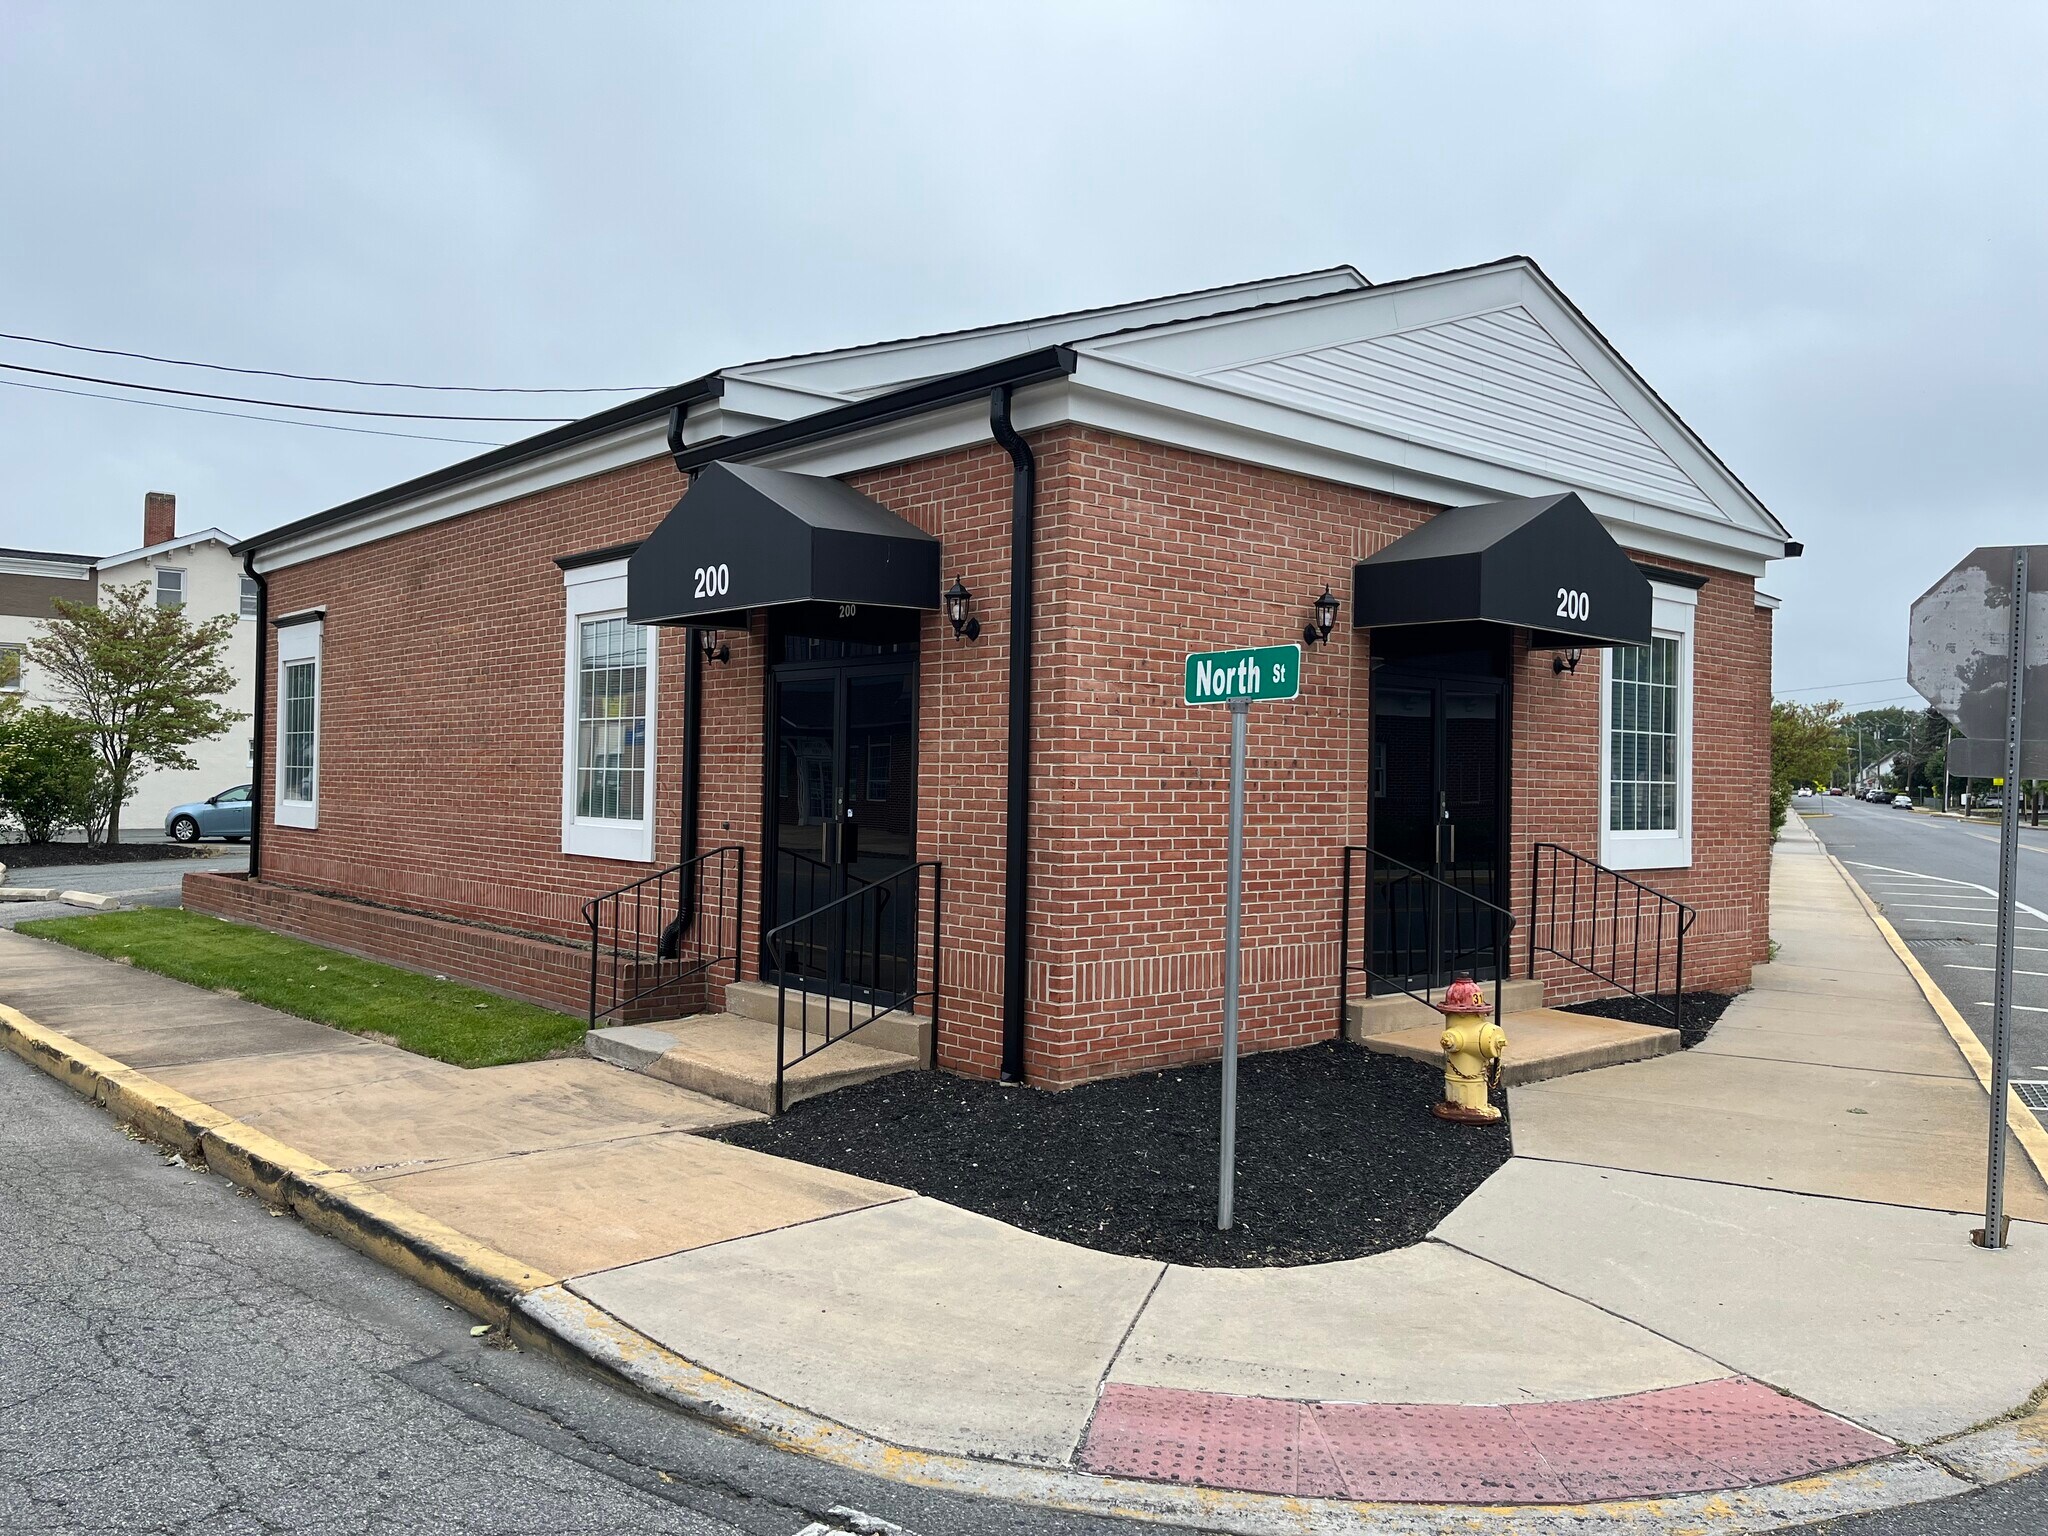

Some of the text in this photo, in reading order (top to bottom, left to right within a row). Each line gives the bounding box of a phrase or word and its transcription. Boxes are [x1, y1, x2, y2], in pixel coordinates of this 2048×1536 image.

[694, 563, 730, 598] 200
[839, 604, 856, 618] 200
[1556, 587, 1590, 622] 200
[1196, 656, 1286, 697] North St
